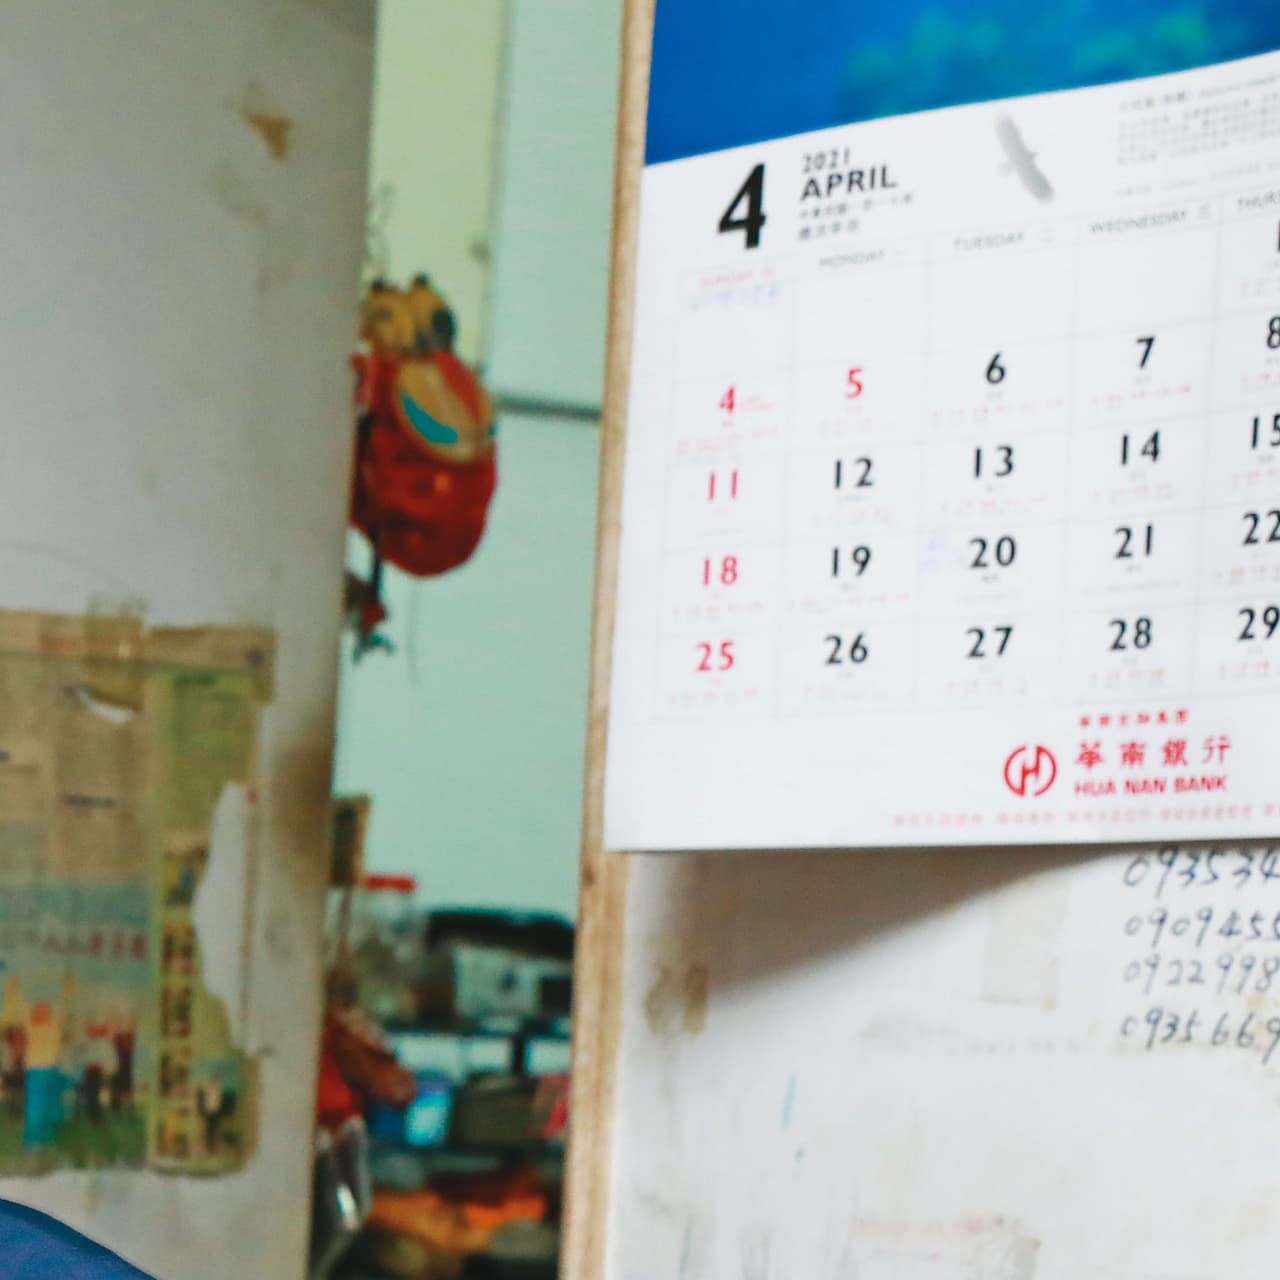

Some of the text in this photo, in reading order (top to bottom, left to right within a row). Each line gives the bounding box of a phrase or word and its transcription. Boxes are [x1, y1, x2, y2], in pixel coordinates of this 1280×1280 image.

[800, 164, 898, 201] APRIL
[803, 148, 851, 173] 2021
[718, 163, 767, 249] 4
[719, 316, 1280, 414] 4 5 6 7 8
[709, 470, 738, 501] 11
[835, 458, 872, 488] 12
[975, 446, 1013, 477] 13
[1122, 431, 1160, 464] 14
[704, 510, 1280, 585] 18 19 20 21 22
[698, 606, 1280, 671] 25 26 27 28 29
[1074, 775, 1227, 796] HUA NAN BANK
[1075, 736, 1230, 770] 華南銀行
